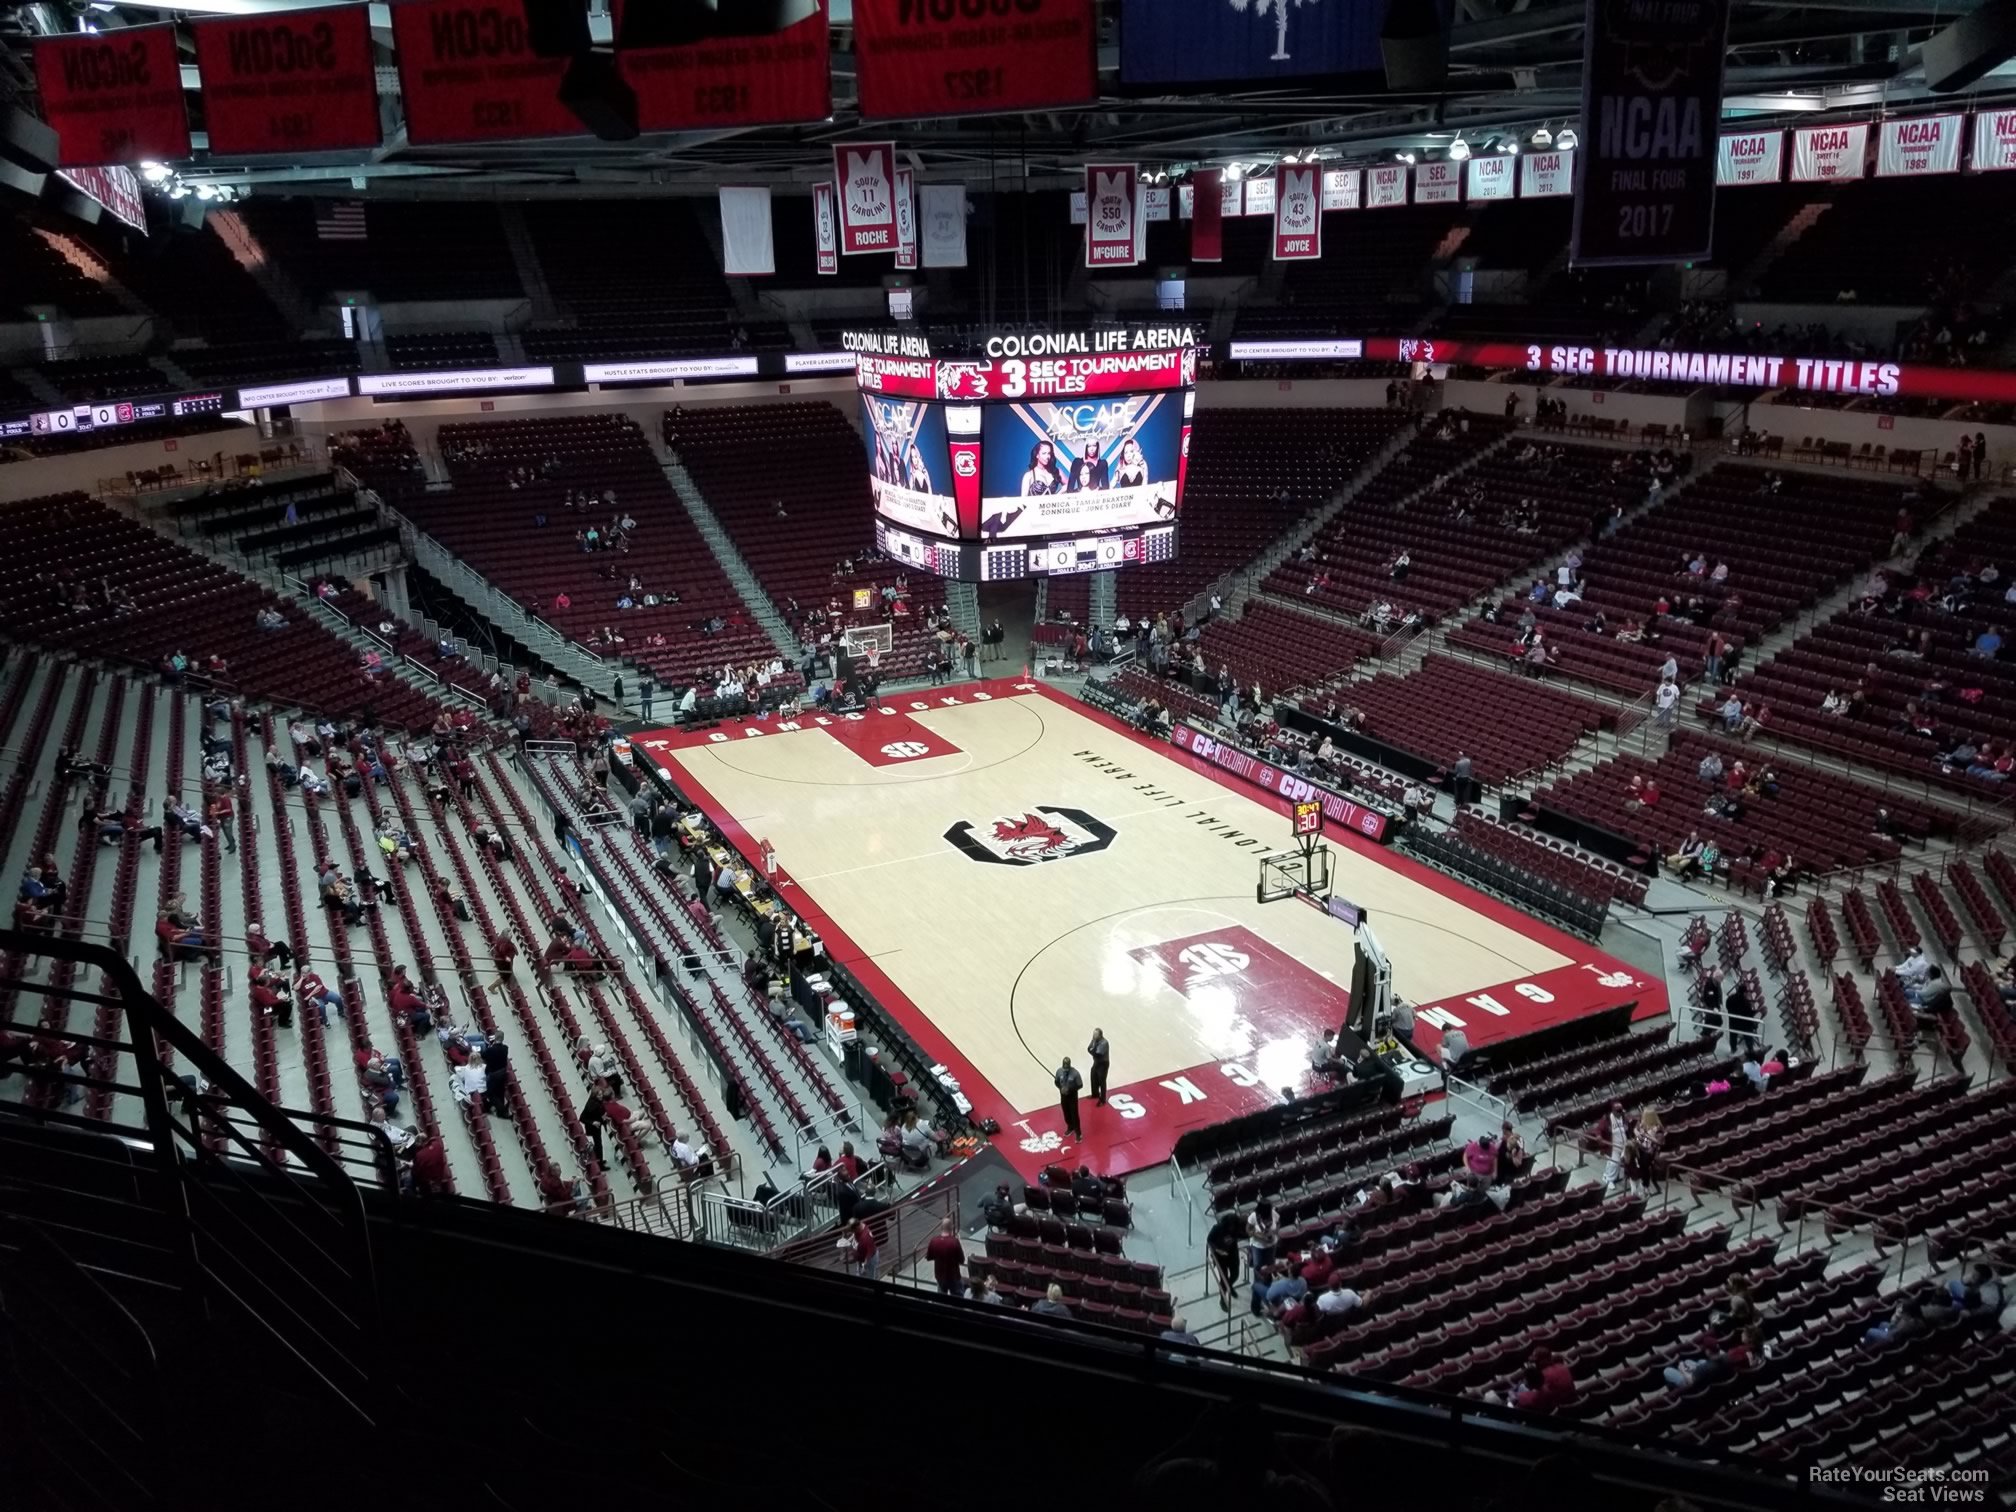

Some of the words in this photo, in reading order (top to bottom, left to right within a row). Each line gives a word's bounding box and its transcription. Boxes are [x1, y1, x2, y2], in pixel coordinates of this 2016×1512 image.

[1600, 95, 1704, 160] NCAA
[1898, 122, 1941, 144] NCAA
[1730, 138, 1766, 156] NCAA
[1810, 131, 1848, 151] NCAA
[1901, 145, 1935, 153] TOURNAMENT
[1479, 160, 1504, 176] NCAA
[1533, 154, 1560, 172] NCAA
[1905, 159, 1927, 170] 1989
[1376, 170, 1398, 184] NCAA
[1430, 166, 1446, 180] SEC
[1738, 170, 1754, 180] 1991
[1817, 165, 1836, 176] 1990
[854, 177, 880, 188] SOUTH
[1334, 174, 1349, 188] SEC
[1611, 169, 1649, 191] FINAL
[1653, 168, 1687, 191] FOUR
[1256, 183, 1268, 194] SEC
[1484, 187, 1496, 196] 2013
[1538, 184, 1553, 192] 2012
[862, 189, 874, 202] 11
[1146, 192, 1156, 203] EC
[1289, 192, 1308, 202] SOUTH
[852, 202, 886, 217] CAROLINA
[1102, 207, 1121, 220] 550
[1292, 204, 1304, 215] 43
[1096, 220, 1127, 233] CAROLINA
[1284, 215, 1311, 228] CAROLINA
[1618, 204, 1675, 238] 2017
[856, 230, 888, 246] ROCHE
[1094, 246, 1130, 260] McGUIRE
[1284, 240, 1310, 252] JOYCE
[842, 332, 882, 352] COLONIAL
[884, 335, 898, 354] LIFE
[900, 336, 930, 358] ARENA
[986, 332, 1088, 358] COLONIAL
[1095, 331, 1127, 352] LIFE
[1132, 328, 1194, 349] ARENA
[856, 353, 864, 388] 3
[864, 356, 874, 374] SEC
[874, 358, 932, 379] TOURNAMENT
[1030, 361, 1067, 378] SEC
[1070, 352, 1178, 375] TOURNAMENT
[1526, 346, 1542, 371] 3
[1551, 346, 1594, 374] SEC
[1604, 348, 1784, 387] TOURNAMENT
[1796, 358, 1900, 395] TITLES
[864, 372, 882, 390] TITLES
[1002, 359, 1026, 398] 3
[1030, 376, 1086, 394] TITLES
[58, 415, 68, 428] 0
[100, 410, 109, 422] 0
[1102, 494, 1134, 503] BRAXTON
[1041, 507, 1080, 516] ZONNIQUE
[1111, 501, 1131, 510] DIARY
[1058, 552, 1067, 564] 0
[1106, 546, 1115, 559] 0
[1077, 562, 1096, 570] 30:47
[856, 596, 869, 608] 30
[709, 692, 992, 742] GAMECOCKS
[1176, 730, 1188, 740] CPI
[880, 741, 930, 758] SEC
[1073, 750, 1137, 780] ARENA
[1220, 745, 1256, 777] SECURITY
[1261, 772, 1273, 781] CPI
[1133, 783, 1184, 807] LIFE
[1279, 775, 1316, 801] CPI
[1297, 802, 1320, 816] 30:47
[1300, 813, 1317, 831] 30
[1364, 819, 1377, 828] CPI
